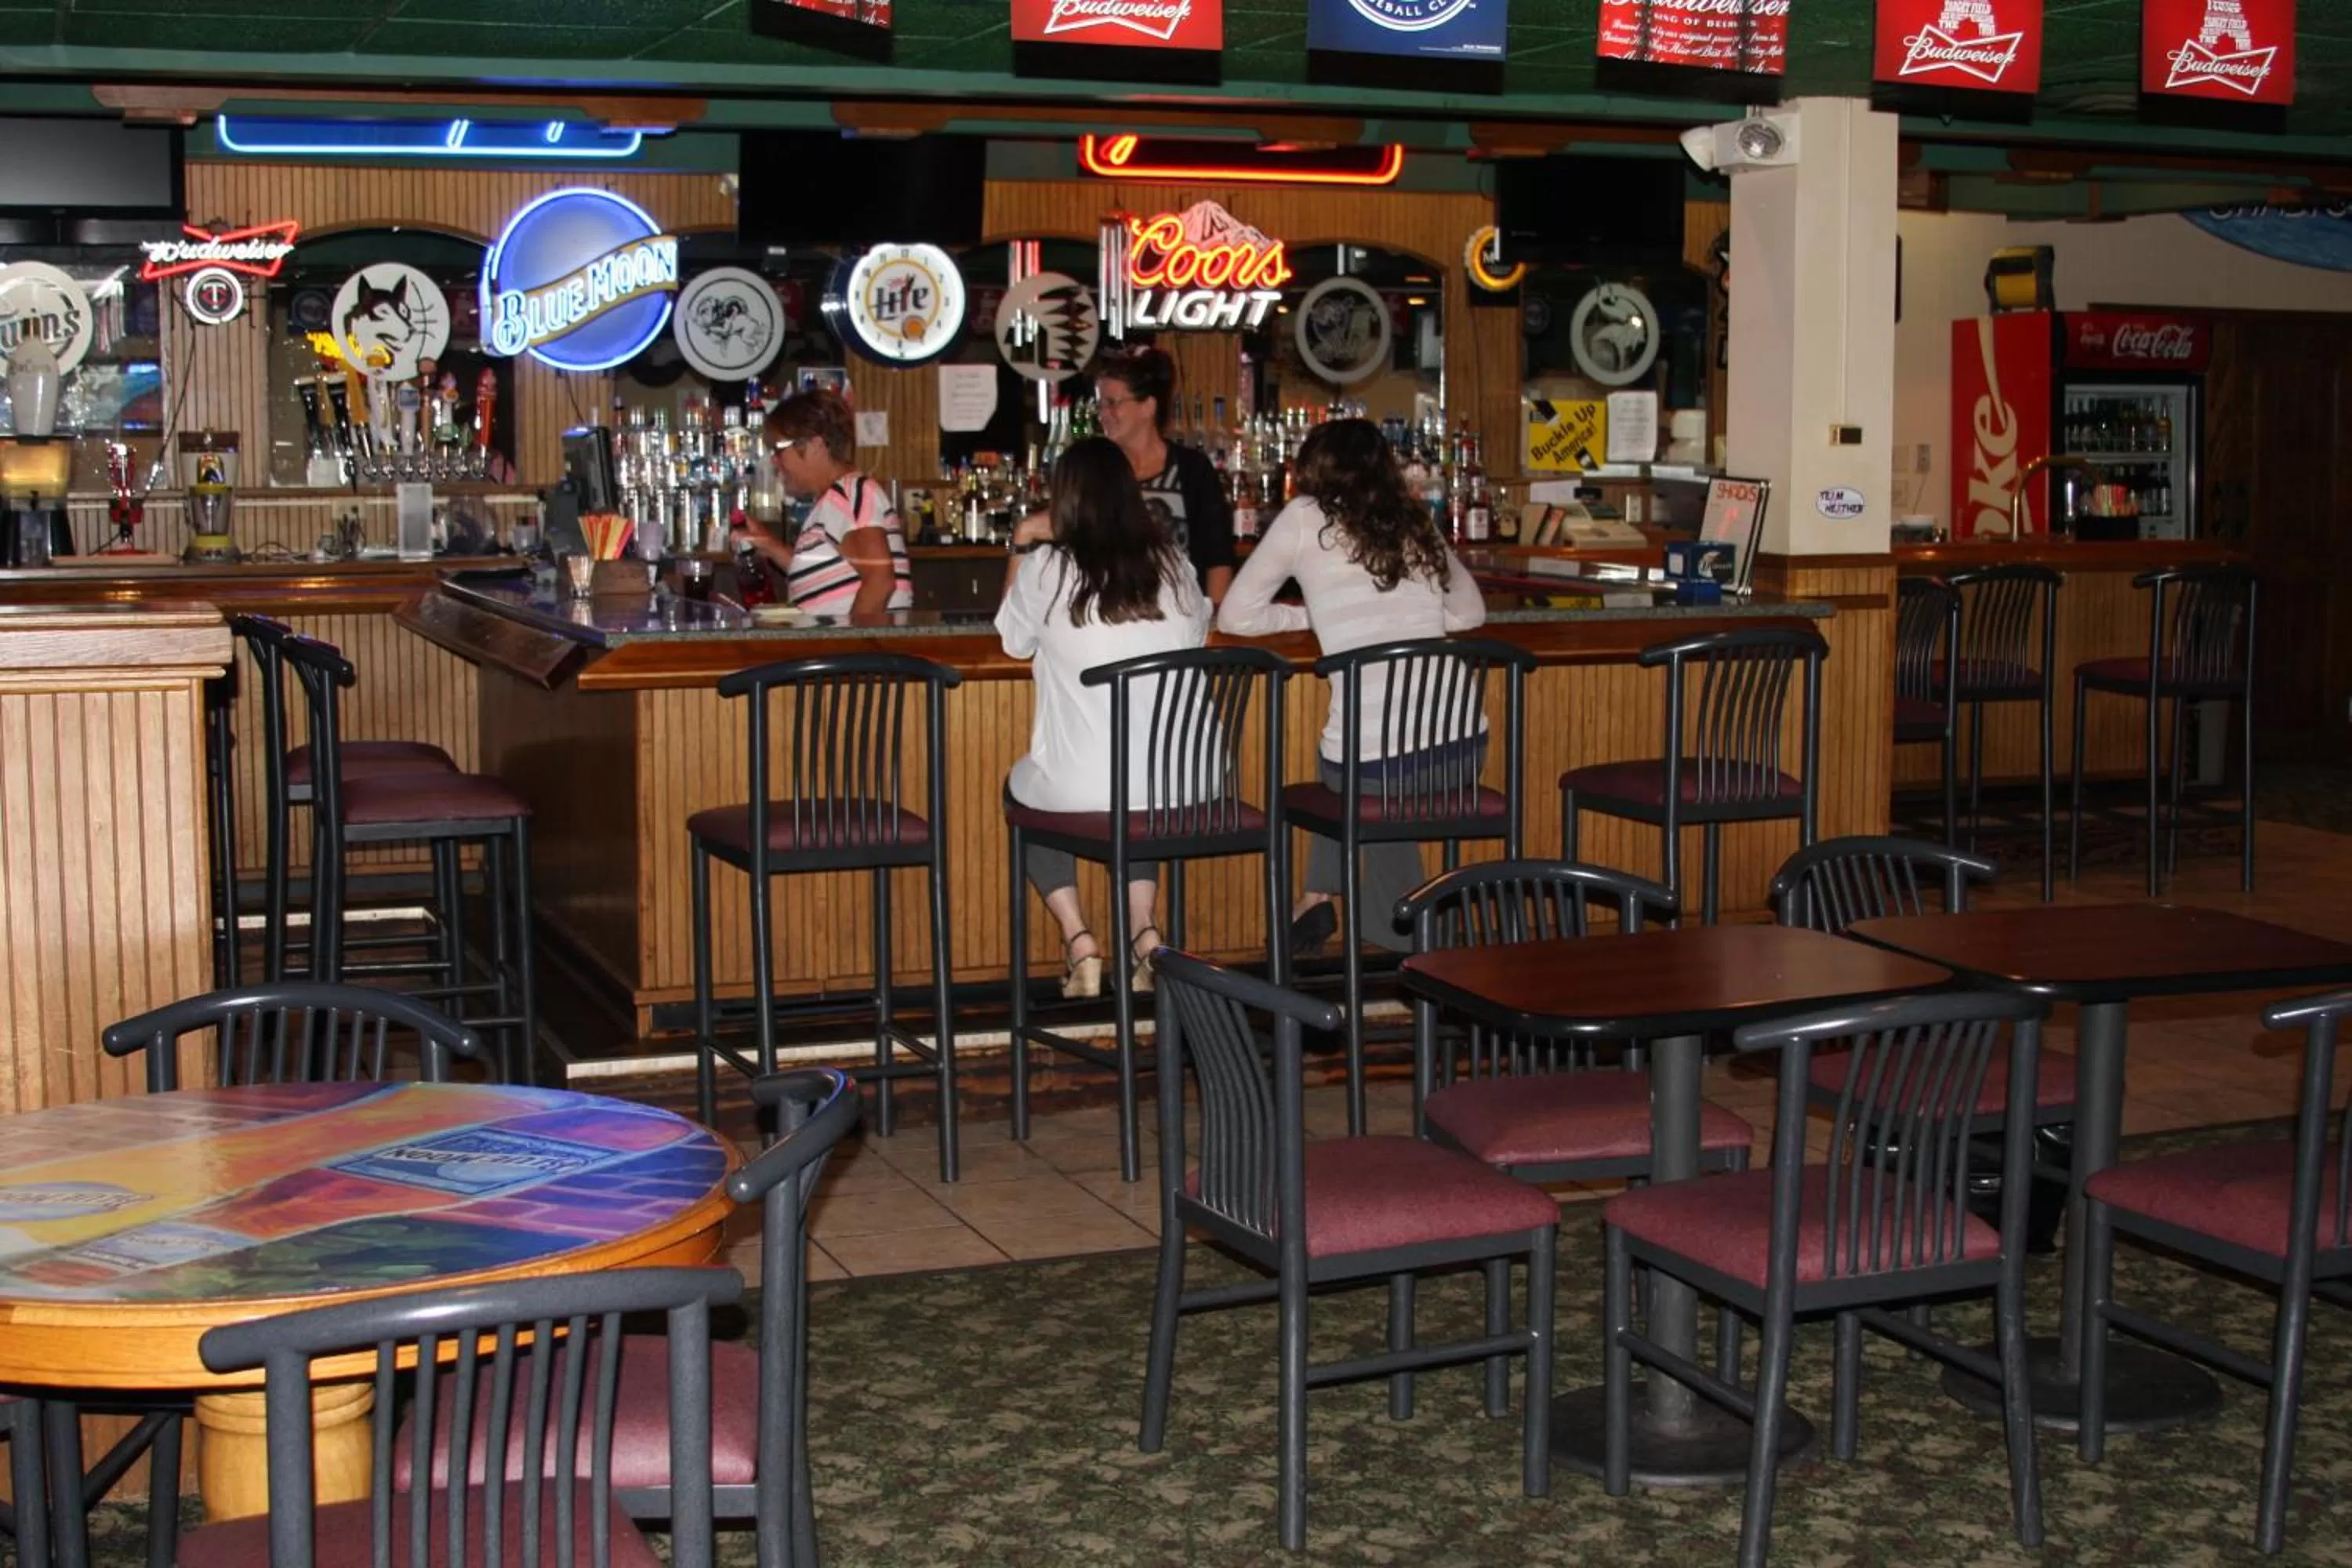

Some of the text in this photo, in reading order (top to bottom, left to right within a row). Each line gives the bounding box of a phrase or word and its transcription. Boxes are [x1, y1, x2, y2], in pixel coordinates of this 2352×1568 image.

[1683, 17, 1700, 26] OF
[1904, 35, 2016, 64] Budweiser
[2167, 50, 2270, 78] Budweiser
[1130, 214, 1292, 288] Coors
[586, 240, 678, 312] MOON
[1134, 289, 1283, 327] LIGHT
[1530, 421, 1576, 462] Buckle
[1573, 403, 1597, 423] Up
